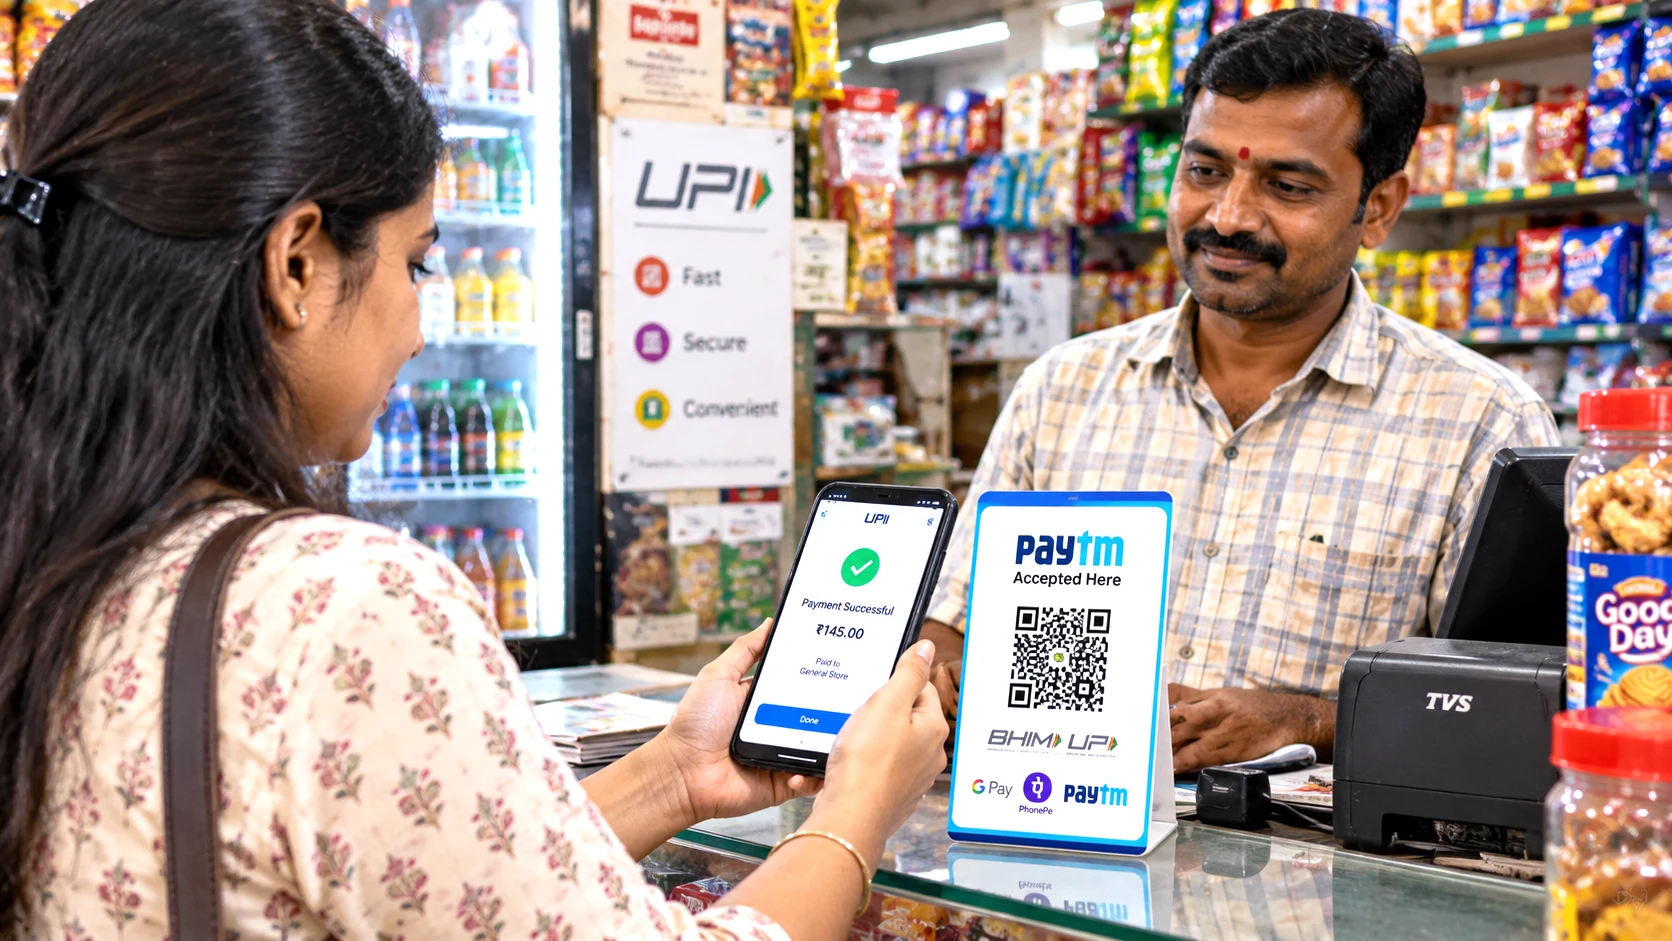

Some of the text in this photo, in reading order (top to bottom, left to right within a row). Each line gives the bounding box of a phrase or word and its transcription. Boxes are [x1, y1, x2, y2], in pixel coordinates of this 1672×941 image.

[635, 160, 752, 213] UPI
[682, 266, 723, 288] Fast
[683, 332, 748, 353] Secure
[683, 398, 779, 420] Convenient
[1013, 571, 1122, 587] Accepted Here
[801, 597, 895, 617] Payment Successful
[815, 623, 865, 640] ₹145.00
[1610, 623, 1672, 665] Day
[815, 657, 841, 668] Paid to
[799, 667, 849, 681] General Store
[1425, 692, 1474, 713] TVS
[799, 715, 820, 726] Done
[987, 729, 1055, 748] BHIM
[988, 780, 1014, 798] Pay
[1018, 805, 1054, 815] PhonePe
